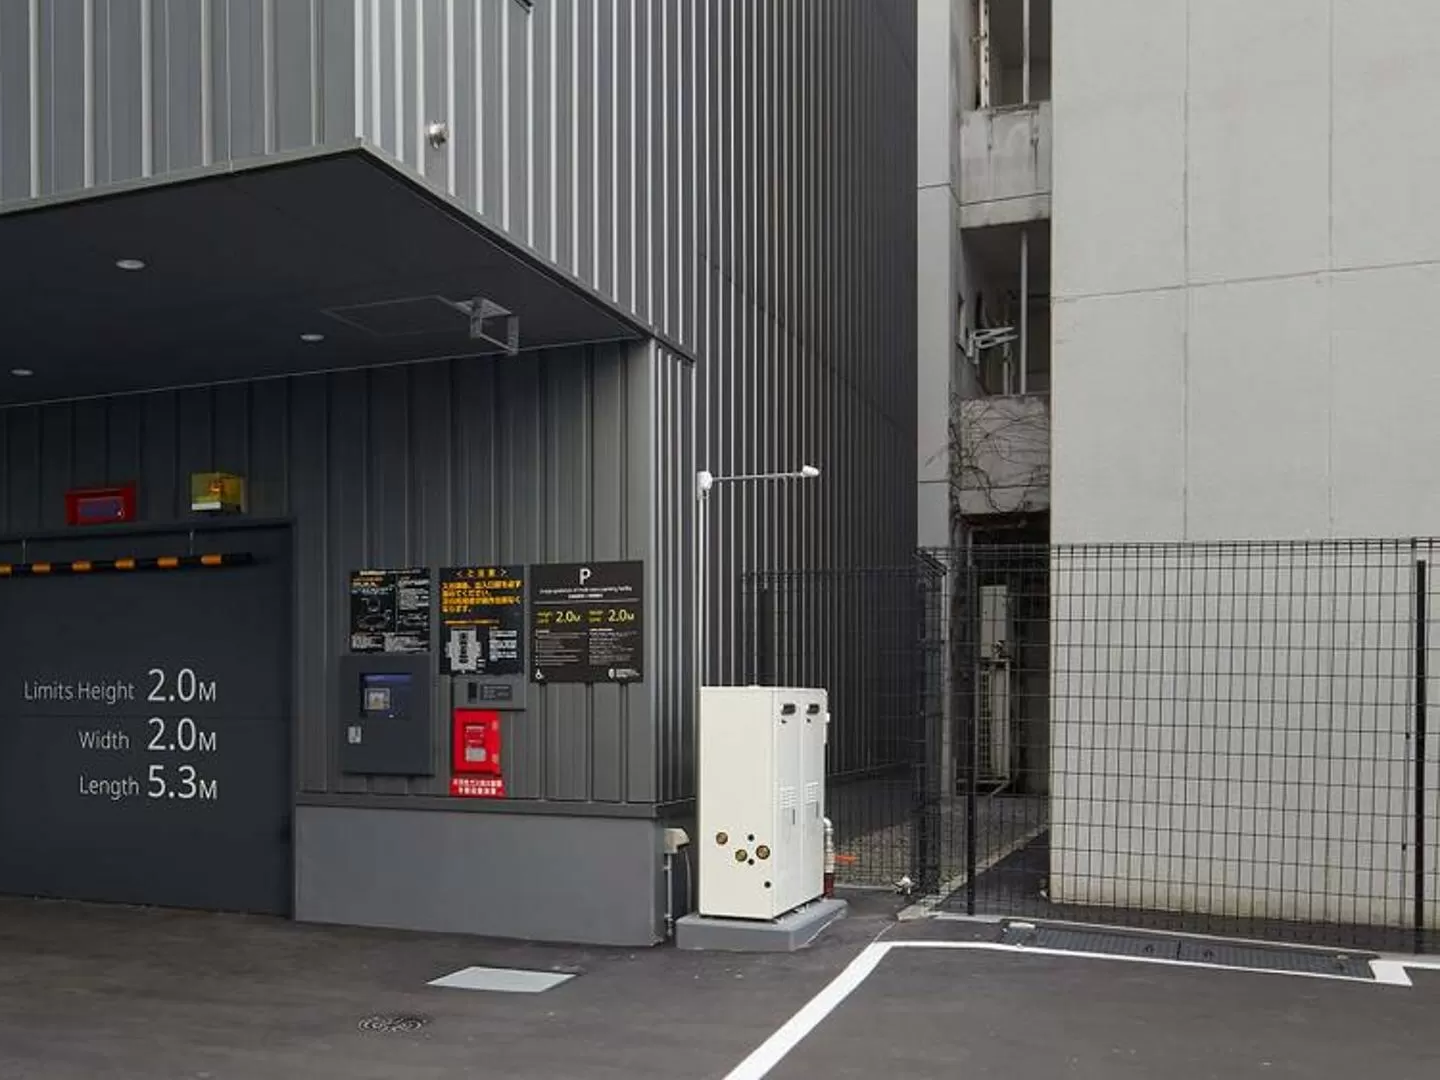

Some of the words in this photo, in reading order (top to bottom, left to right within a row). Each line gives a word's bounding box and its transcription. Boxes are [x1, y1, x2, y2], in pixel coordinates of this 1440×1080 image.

[579, 568, 592, 585] P
[23, 681, 74, 700] Limits
[78, 681, 135, 704] Height
[147, 668, 217, 702] 2.0M
[78, 730, 130, 750] Width
[147, 717, 217, 751] 2.0M
[79, 775, 140, 801] Length
[147, 764, 219, 800] 5.3M
